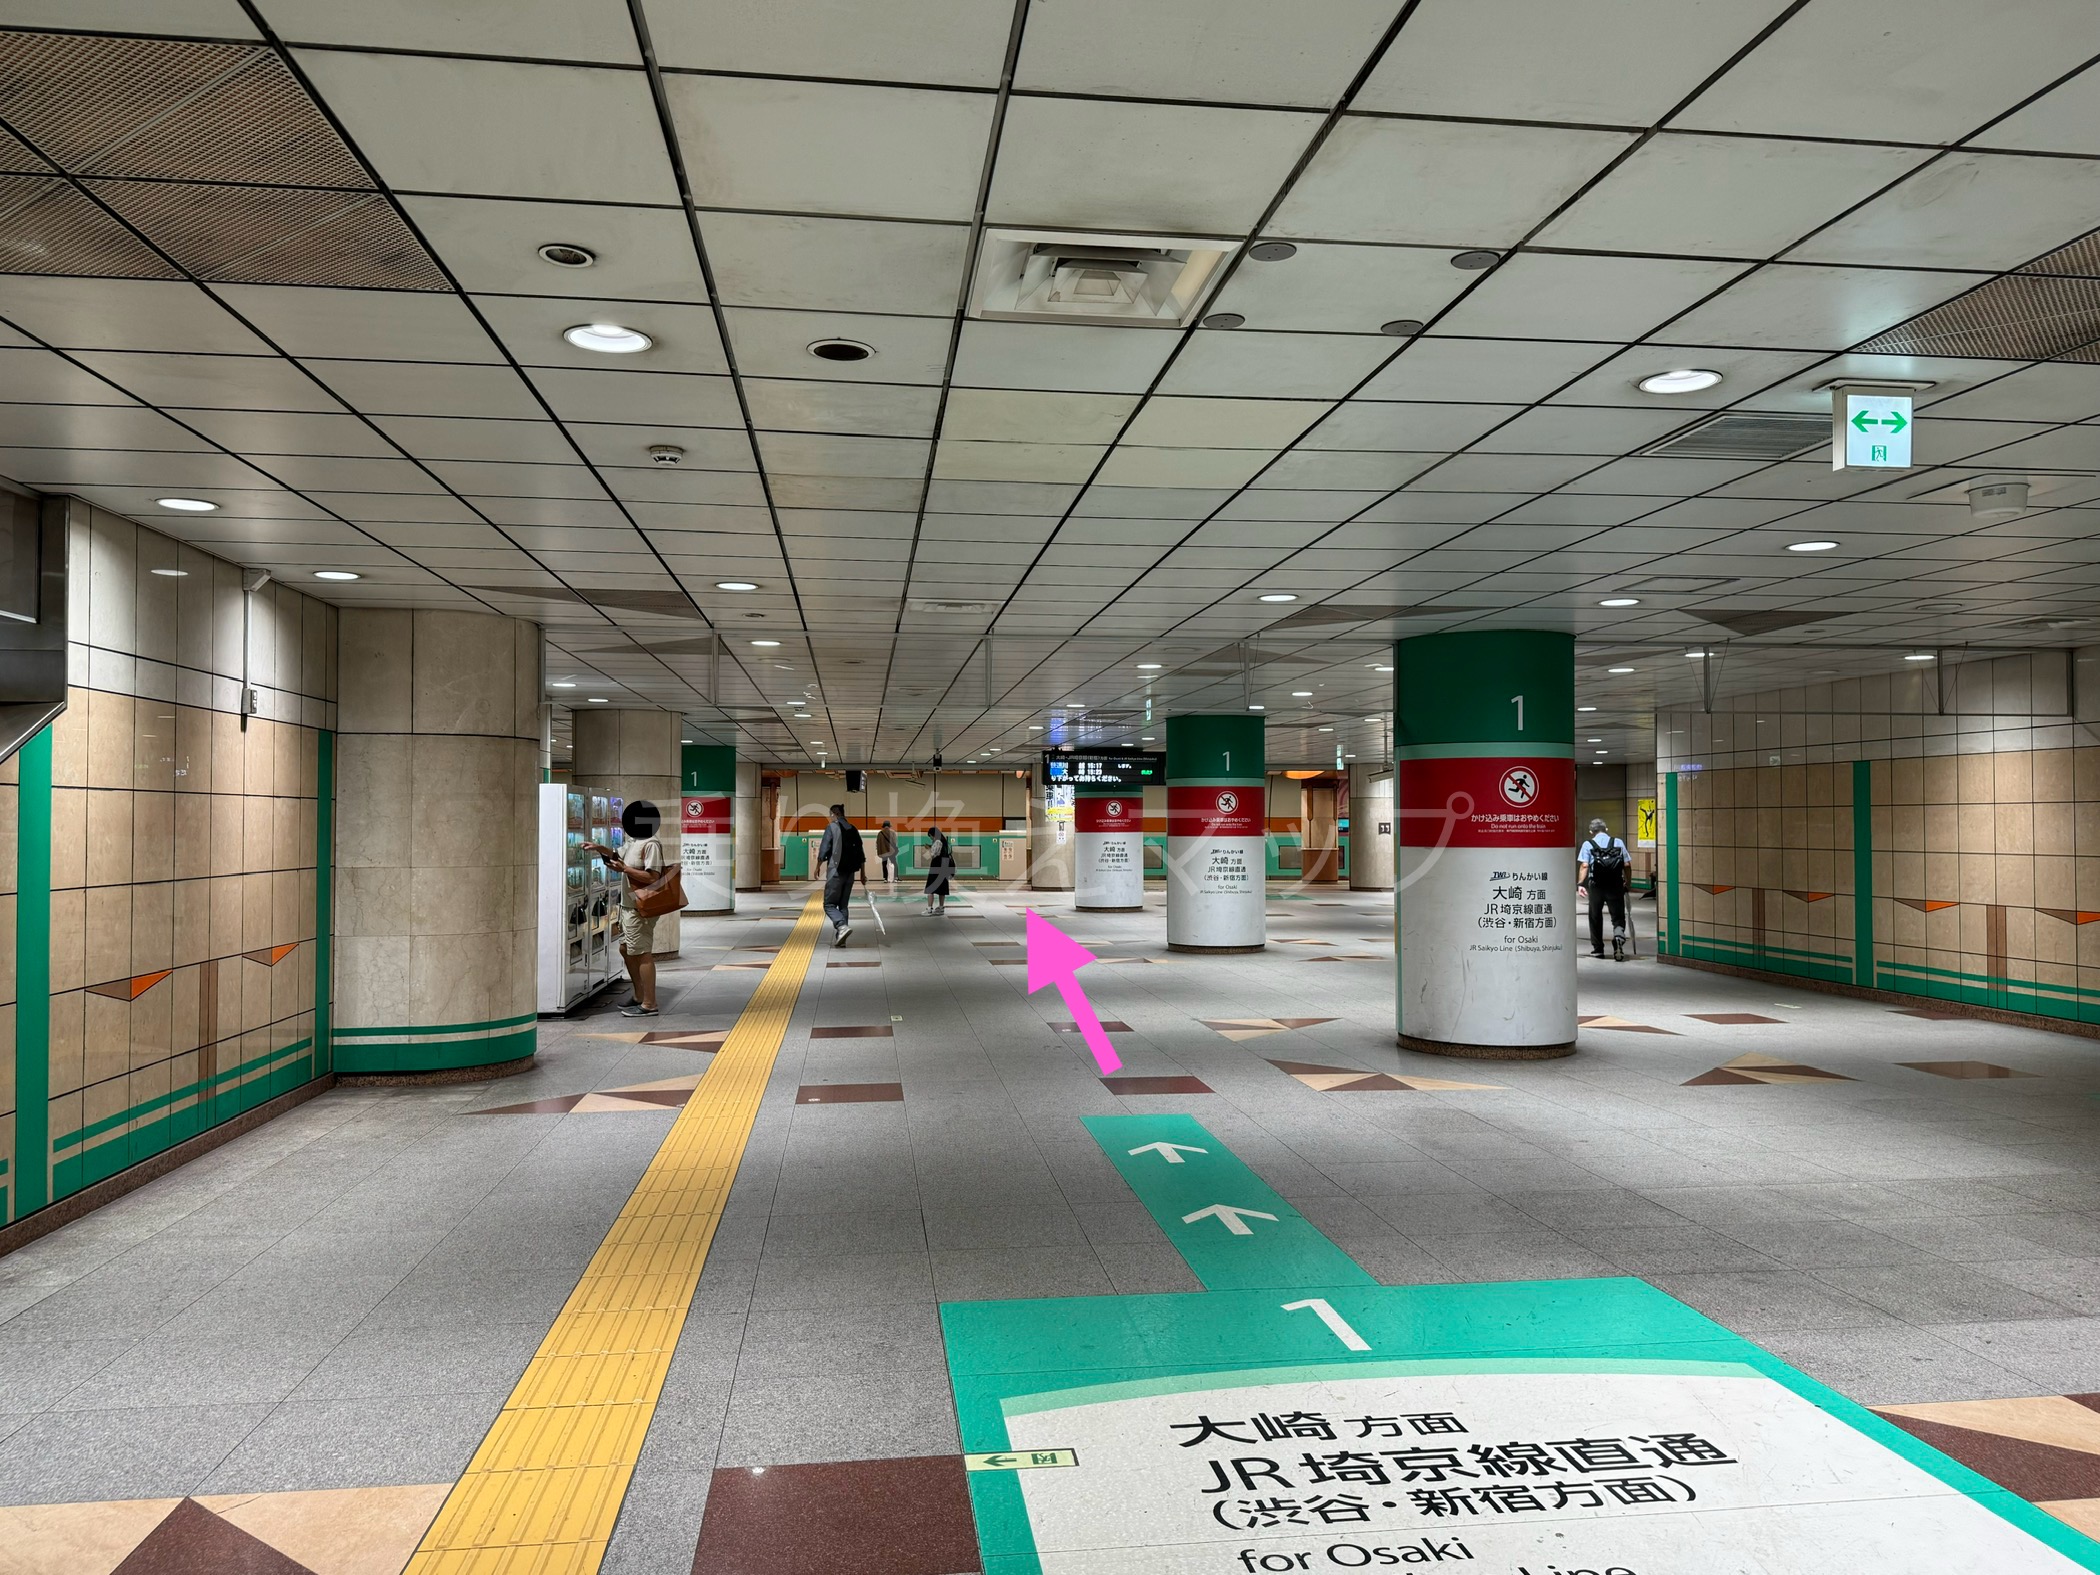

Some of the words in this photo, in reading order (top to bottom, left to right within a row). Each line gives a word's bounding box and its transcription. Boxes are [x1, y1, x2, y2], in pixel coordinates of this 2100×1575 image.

[1511, 695, 1523, 731] 1
[1222, 751, 1230, 771] 1
[690, 771, 697, 787] 1
[1512, 872, 1548, 881] りんかい線
[1493, 886, 1522, 900] 大崎
[1527, 889, 1546, 900] 方面
[1478, 944, 1498, 952] Saikyo
[1504, 935, 1516, 944] for
[1517, 935, 1539, 944] Osaki
[1280, 1298, 1373, 1351] 1
[1169, 1411, 1338, 1448] 大崎
[1343, 1411, 1470, 1439] 方面
[1237, 1548, 1312, 1574] for
[1326, 1536, 1475, 1567] Osaki
